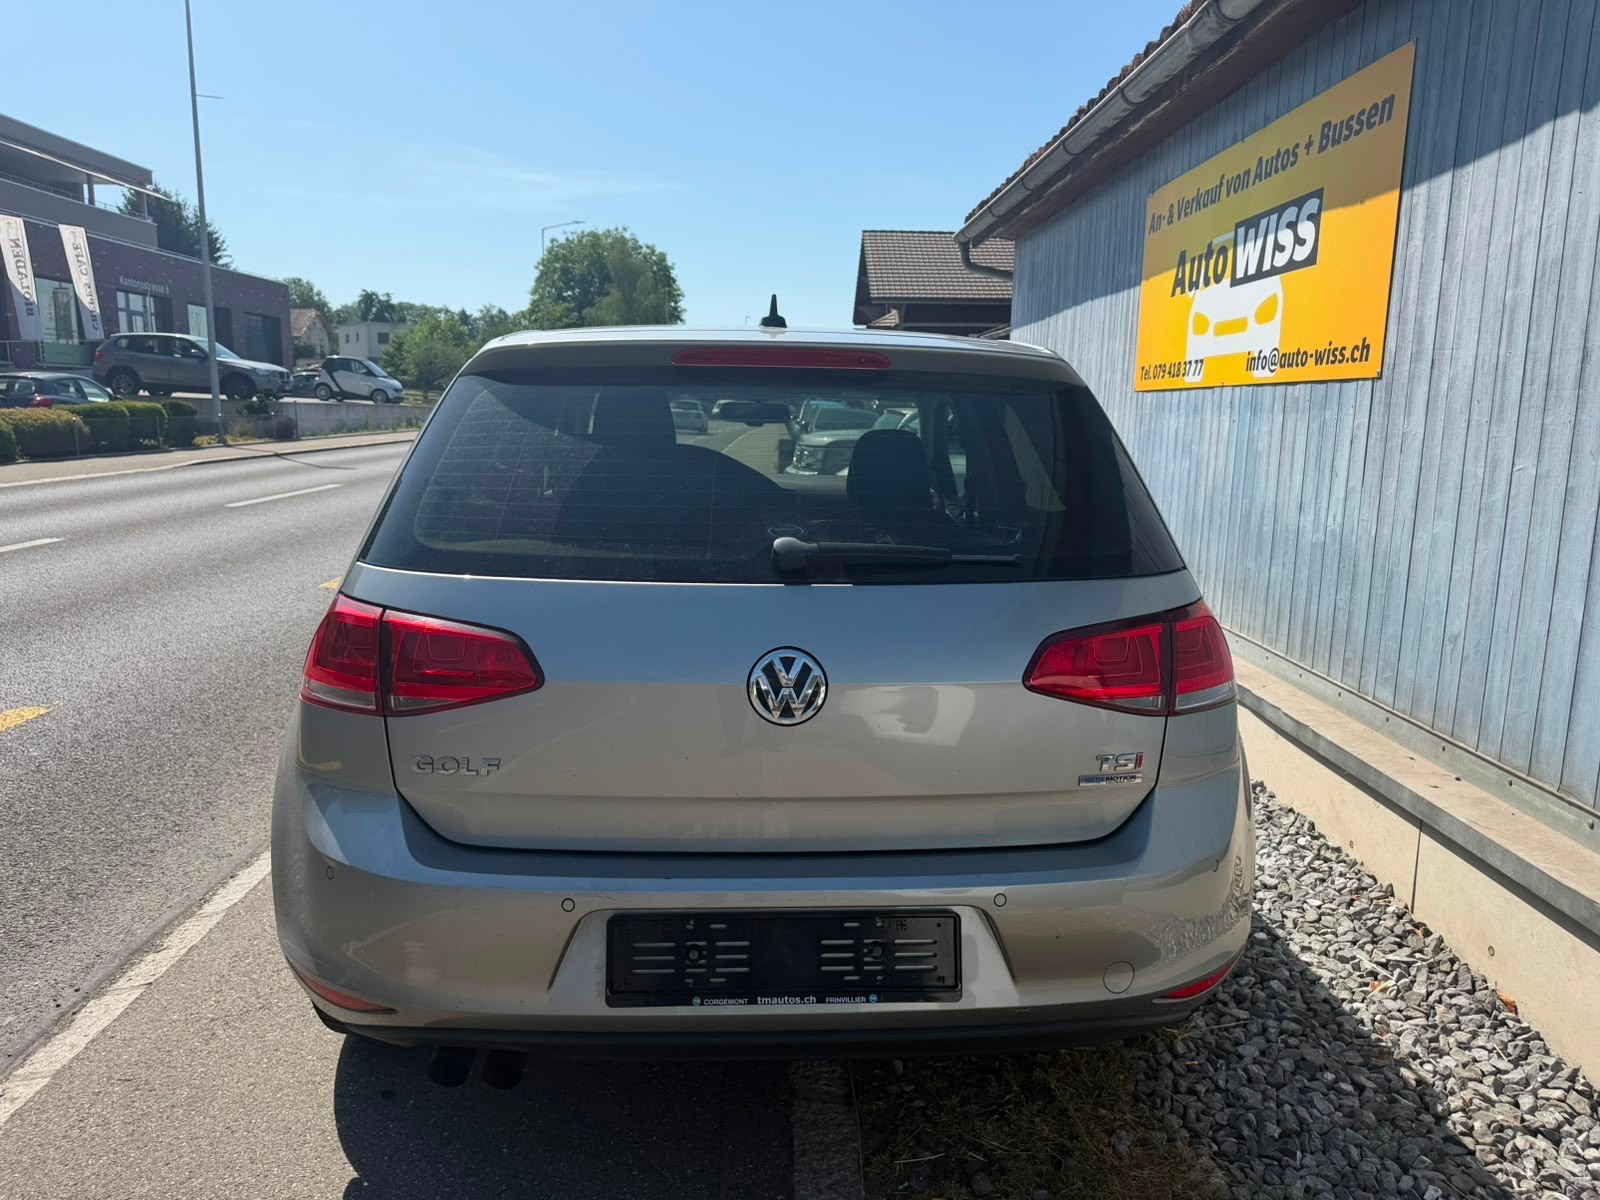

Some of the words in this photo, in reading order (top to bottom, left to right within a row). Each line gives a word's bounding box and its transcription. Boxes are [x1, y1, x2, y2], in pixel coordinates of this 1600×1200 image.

[1148, 211, 1166, 235] An-
[1167, 202, 1174, 226] &
[1177, 174, 1224, 221] Verkauf
[1226, 168, 1251, 199] von
[1252, 142, 1300, 186] Autos
[1304, 134, 1314, 155] +
[1317, 93, 1395, 154] Bussen
[1170, 241, 1229, 298] Auto
[1235, 197, 1321, 280] WISS
[1245, 336, 1371, 374] info@auto-wiss.ch
[1141, 364, 1152, 380] Tel.
[1153, 363, 1167, 380] 079
[748, 647, 827, 726] VW
[410, 754, 501, 776] GOLF
[1096, 752, 1144, 772] TSI
[757, 995, 817, 1005] tmautos.ch
[826, 996, 866, 1004] FRINVILLIER
